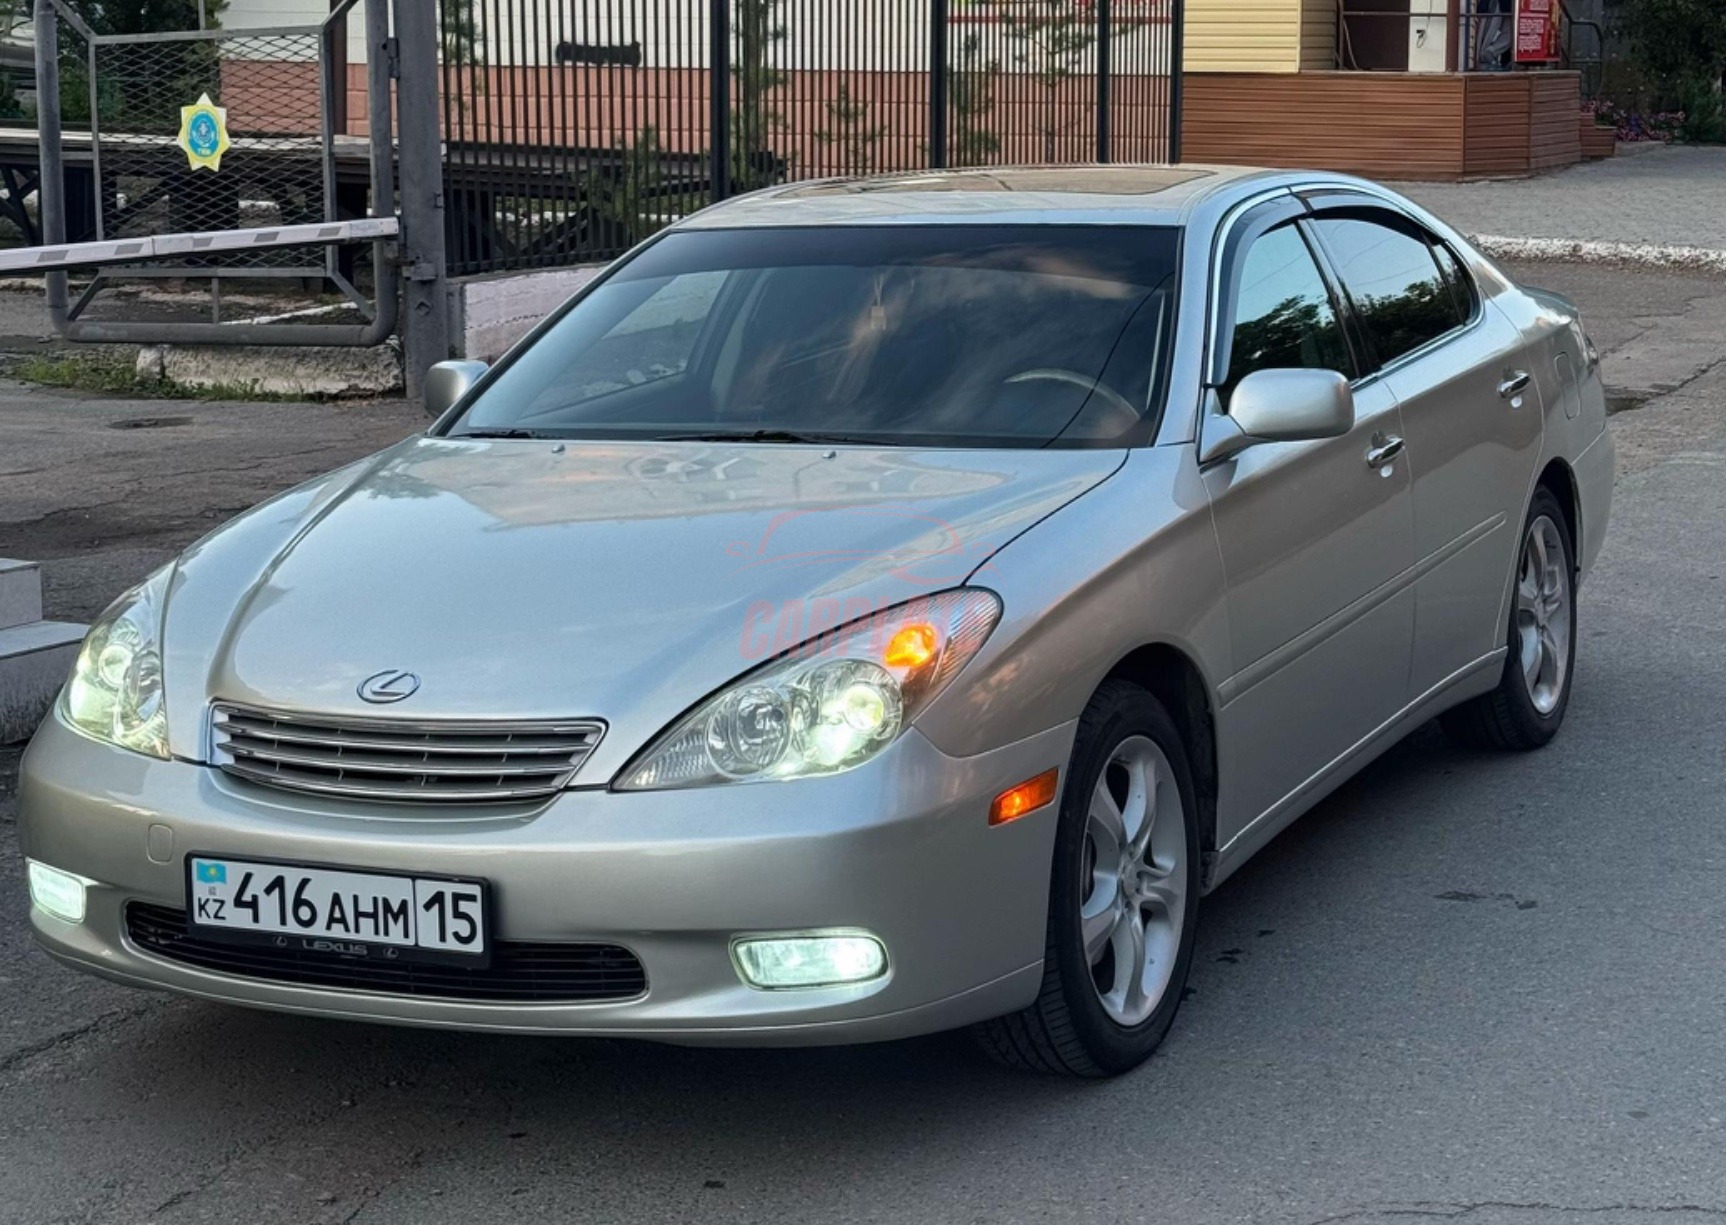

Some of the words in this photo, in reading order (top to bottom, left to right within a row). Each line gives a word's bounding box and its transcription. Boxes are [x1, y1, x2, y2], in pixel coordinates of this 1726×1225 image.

[198, 897, 226, 920] KZ
[422, 890, 478, 945] 15
[302, 939, 367, 956] LEXUS
